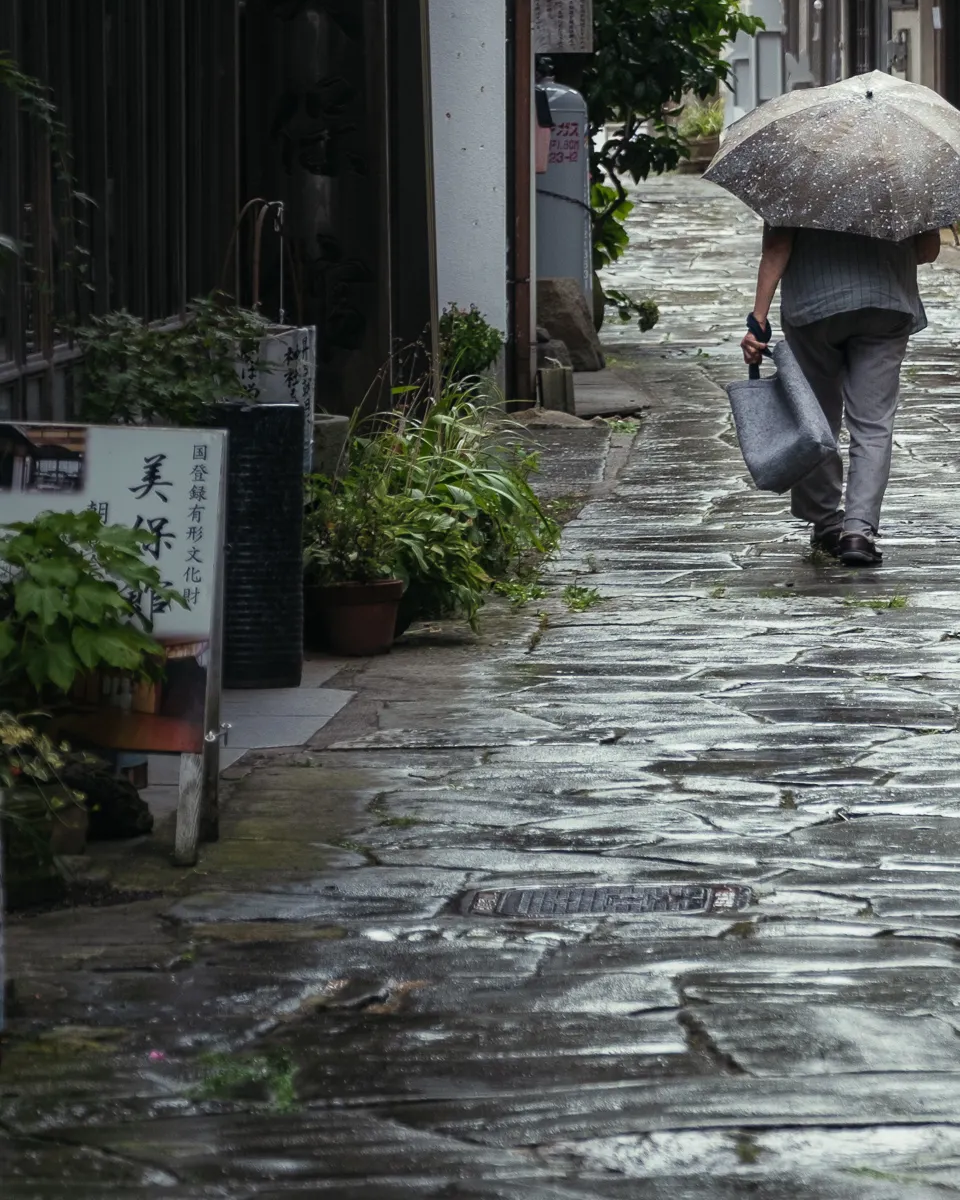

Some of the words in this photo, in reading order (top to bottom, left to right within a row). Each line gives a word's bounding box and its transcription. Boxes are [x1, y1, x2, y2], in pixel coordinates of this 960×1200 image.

[183, 444, 209, 606] 国登録有形文化財
